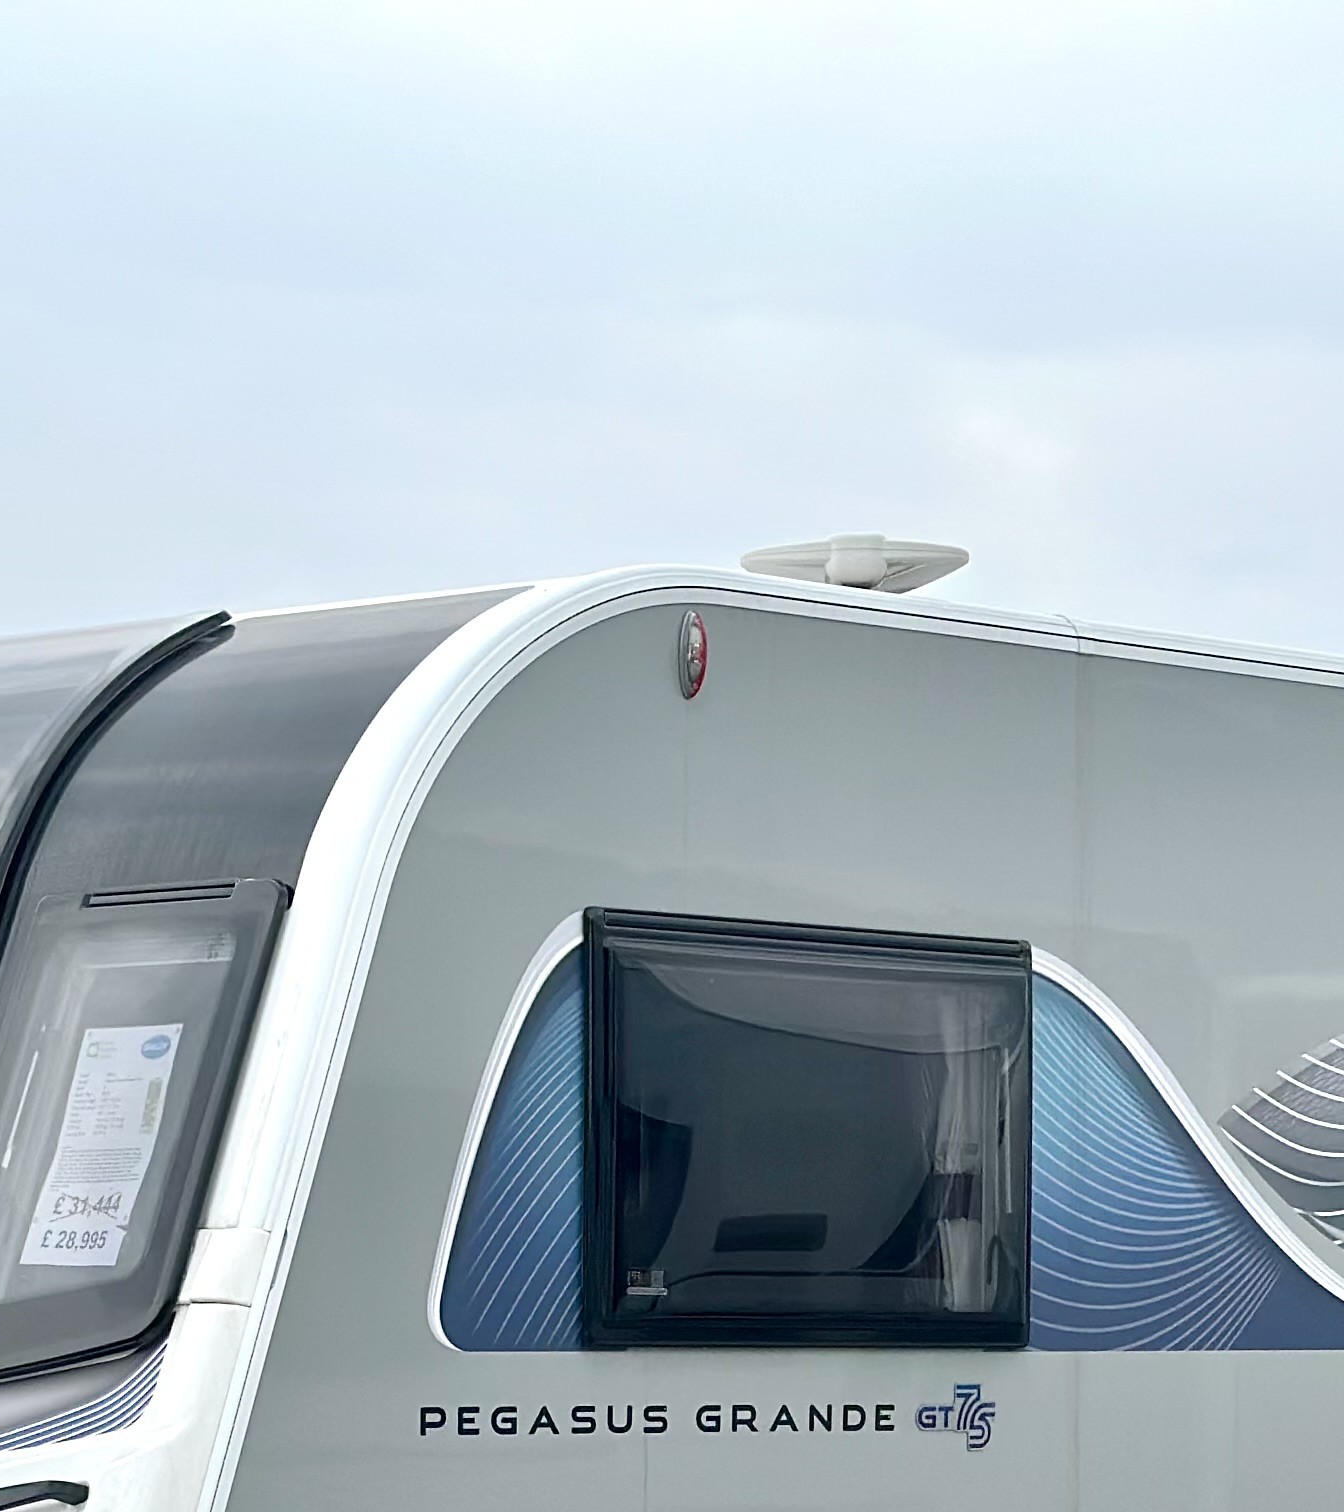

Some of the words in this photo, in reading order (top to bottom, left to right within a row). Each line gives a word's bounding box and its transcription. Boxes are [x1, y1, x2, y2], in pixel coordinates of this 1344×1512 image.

[41, 1229, 53, 1249] £
[54, 1230, 109, 1252] 28,995
[419, 1404, 670, 1436] PEGASUS
[695, 1403, 896, 1434] GRANDE
